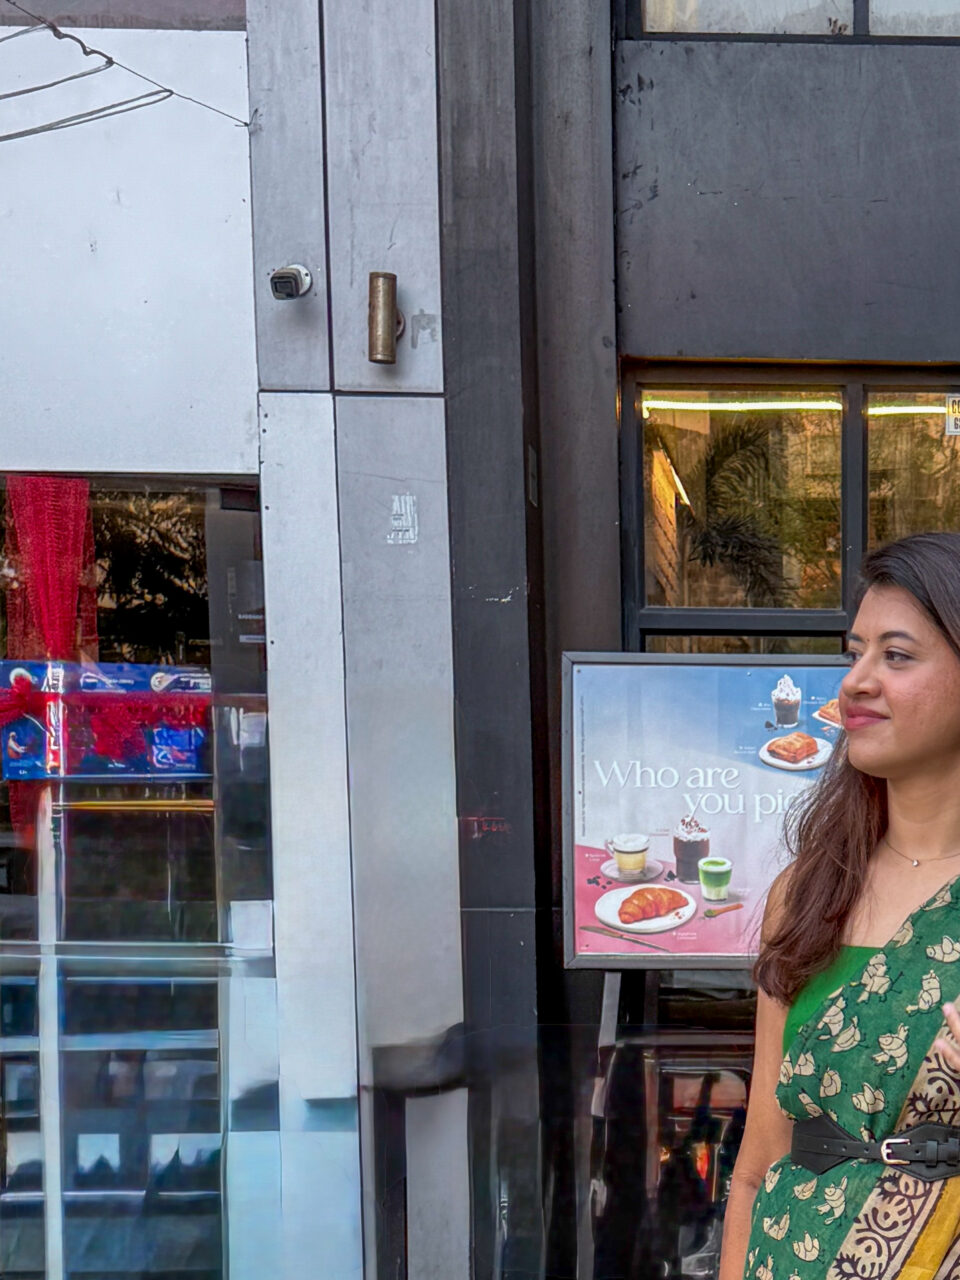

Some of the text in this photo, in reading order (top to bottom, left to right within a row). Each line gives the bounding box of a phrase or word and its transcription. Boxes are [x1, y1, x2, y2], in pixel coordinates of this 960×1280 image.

[592, 760, 740, 789] Who are
[682, 792, 746, 819] you
